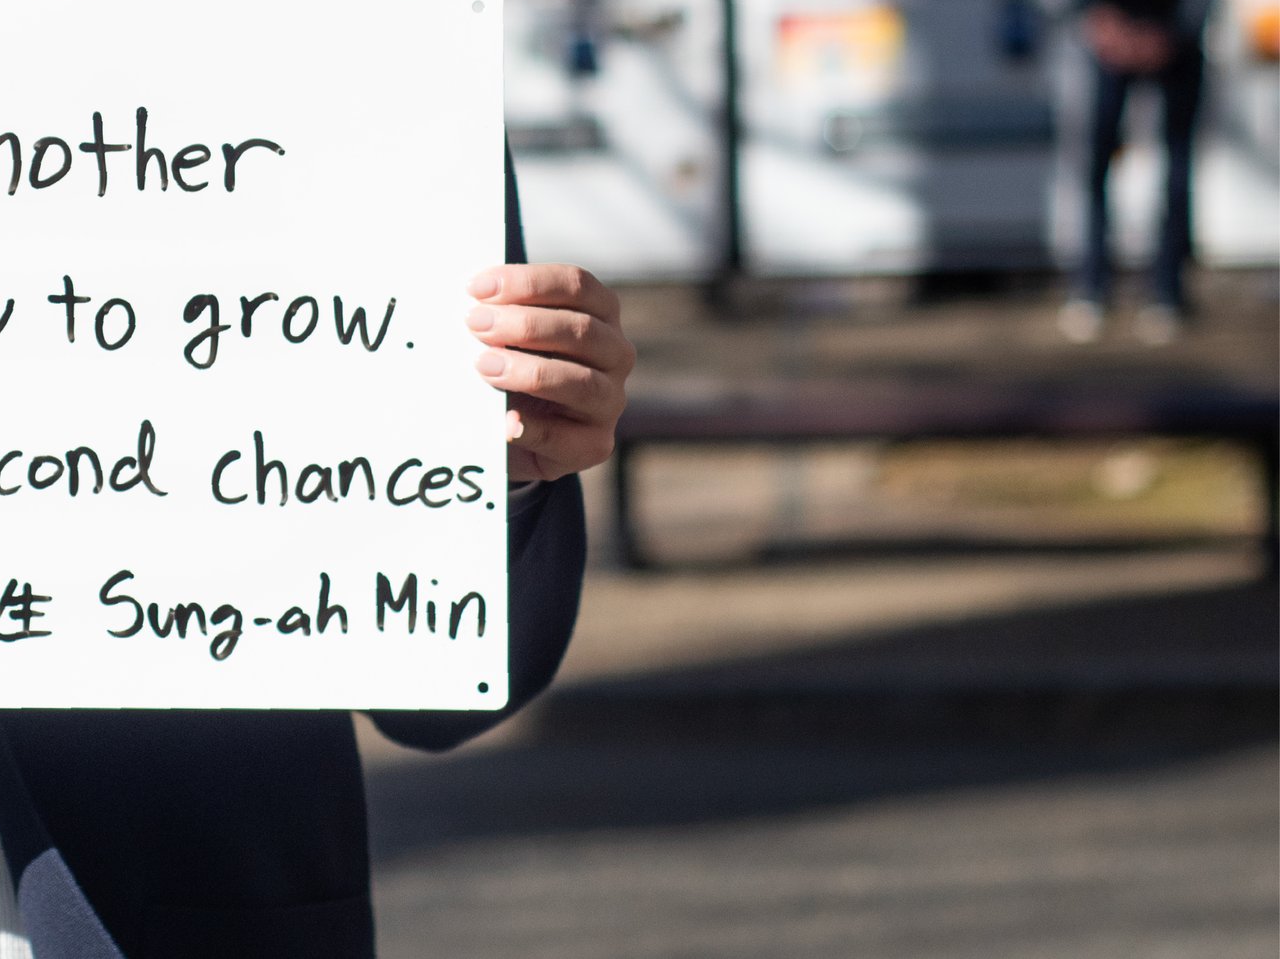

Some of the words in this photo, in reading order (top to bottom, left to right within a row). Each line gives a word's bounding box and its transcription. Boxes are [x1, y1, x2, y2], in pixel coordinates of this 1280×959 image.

[46, 273, 137, 352] to
[181, 291, 417, 371] grow.
[210, 429, 497, 511] chances.
[98, 568, 349, 662] Sung-ah
[375, 570, 487, 641] Min
